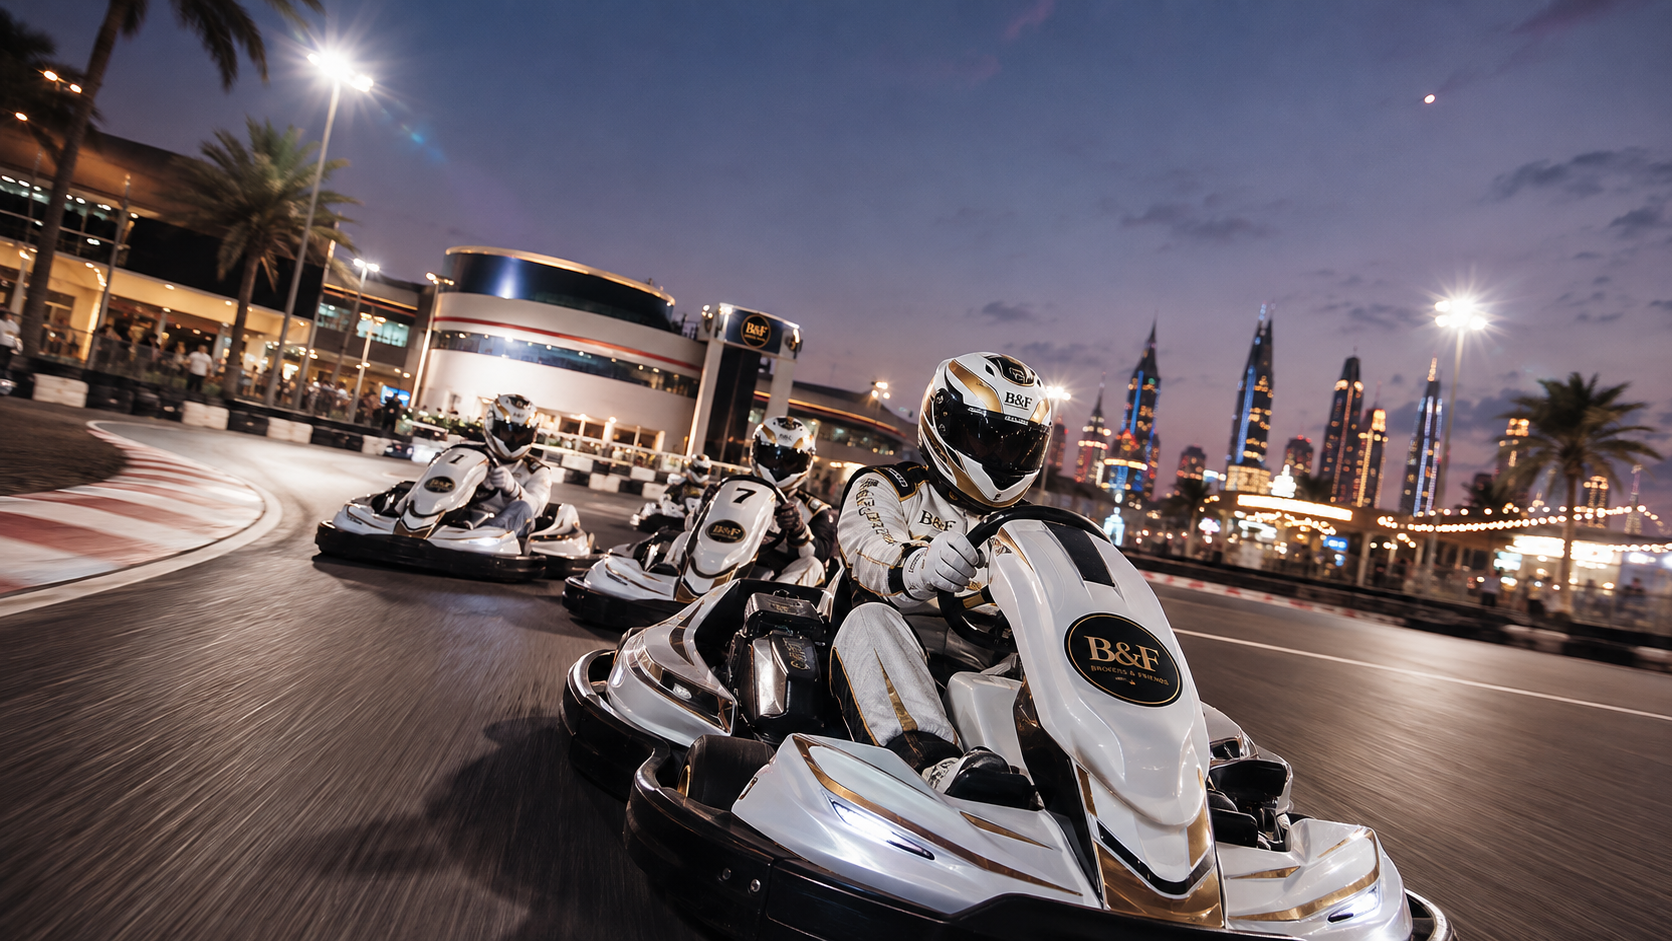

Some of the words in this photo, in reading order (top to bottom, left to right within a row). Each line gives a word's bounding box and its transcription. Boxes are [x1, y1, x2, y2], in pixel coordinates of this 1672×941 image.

[1004, 392, 1032, 408] B&F
[732, 487, 757, 504] 7
[918, 510, 957, 531] B&F
[1083, 635, 1160, 672] B&F
